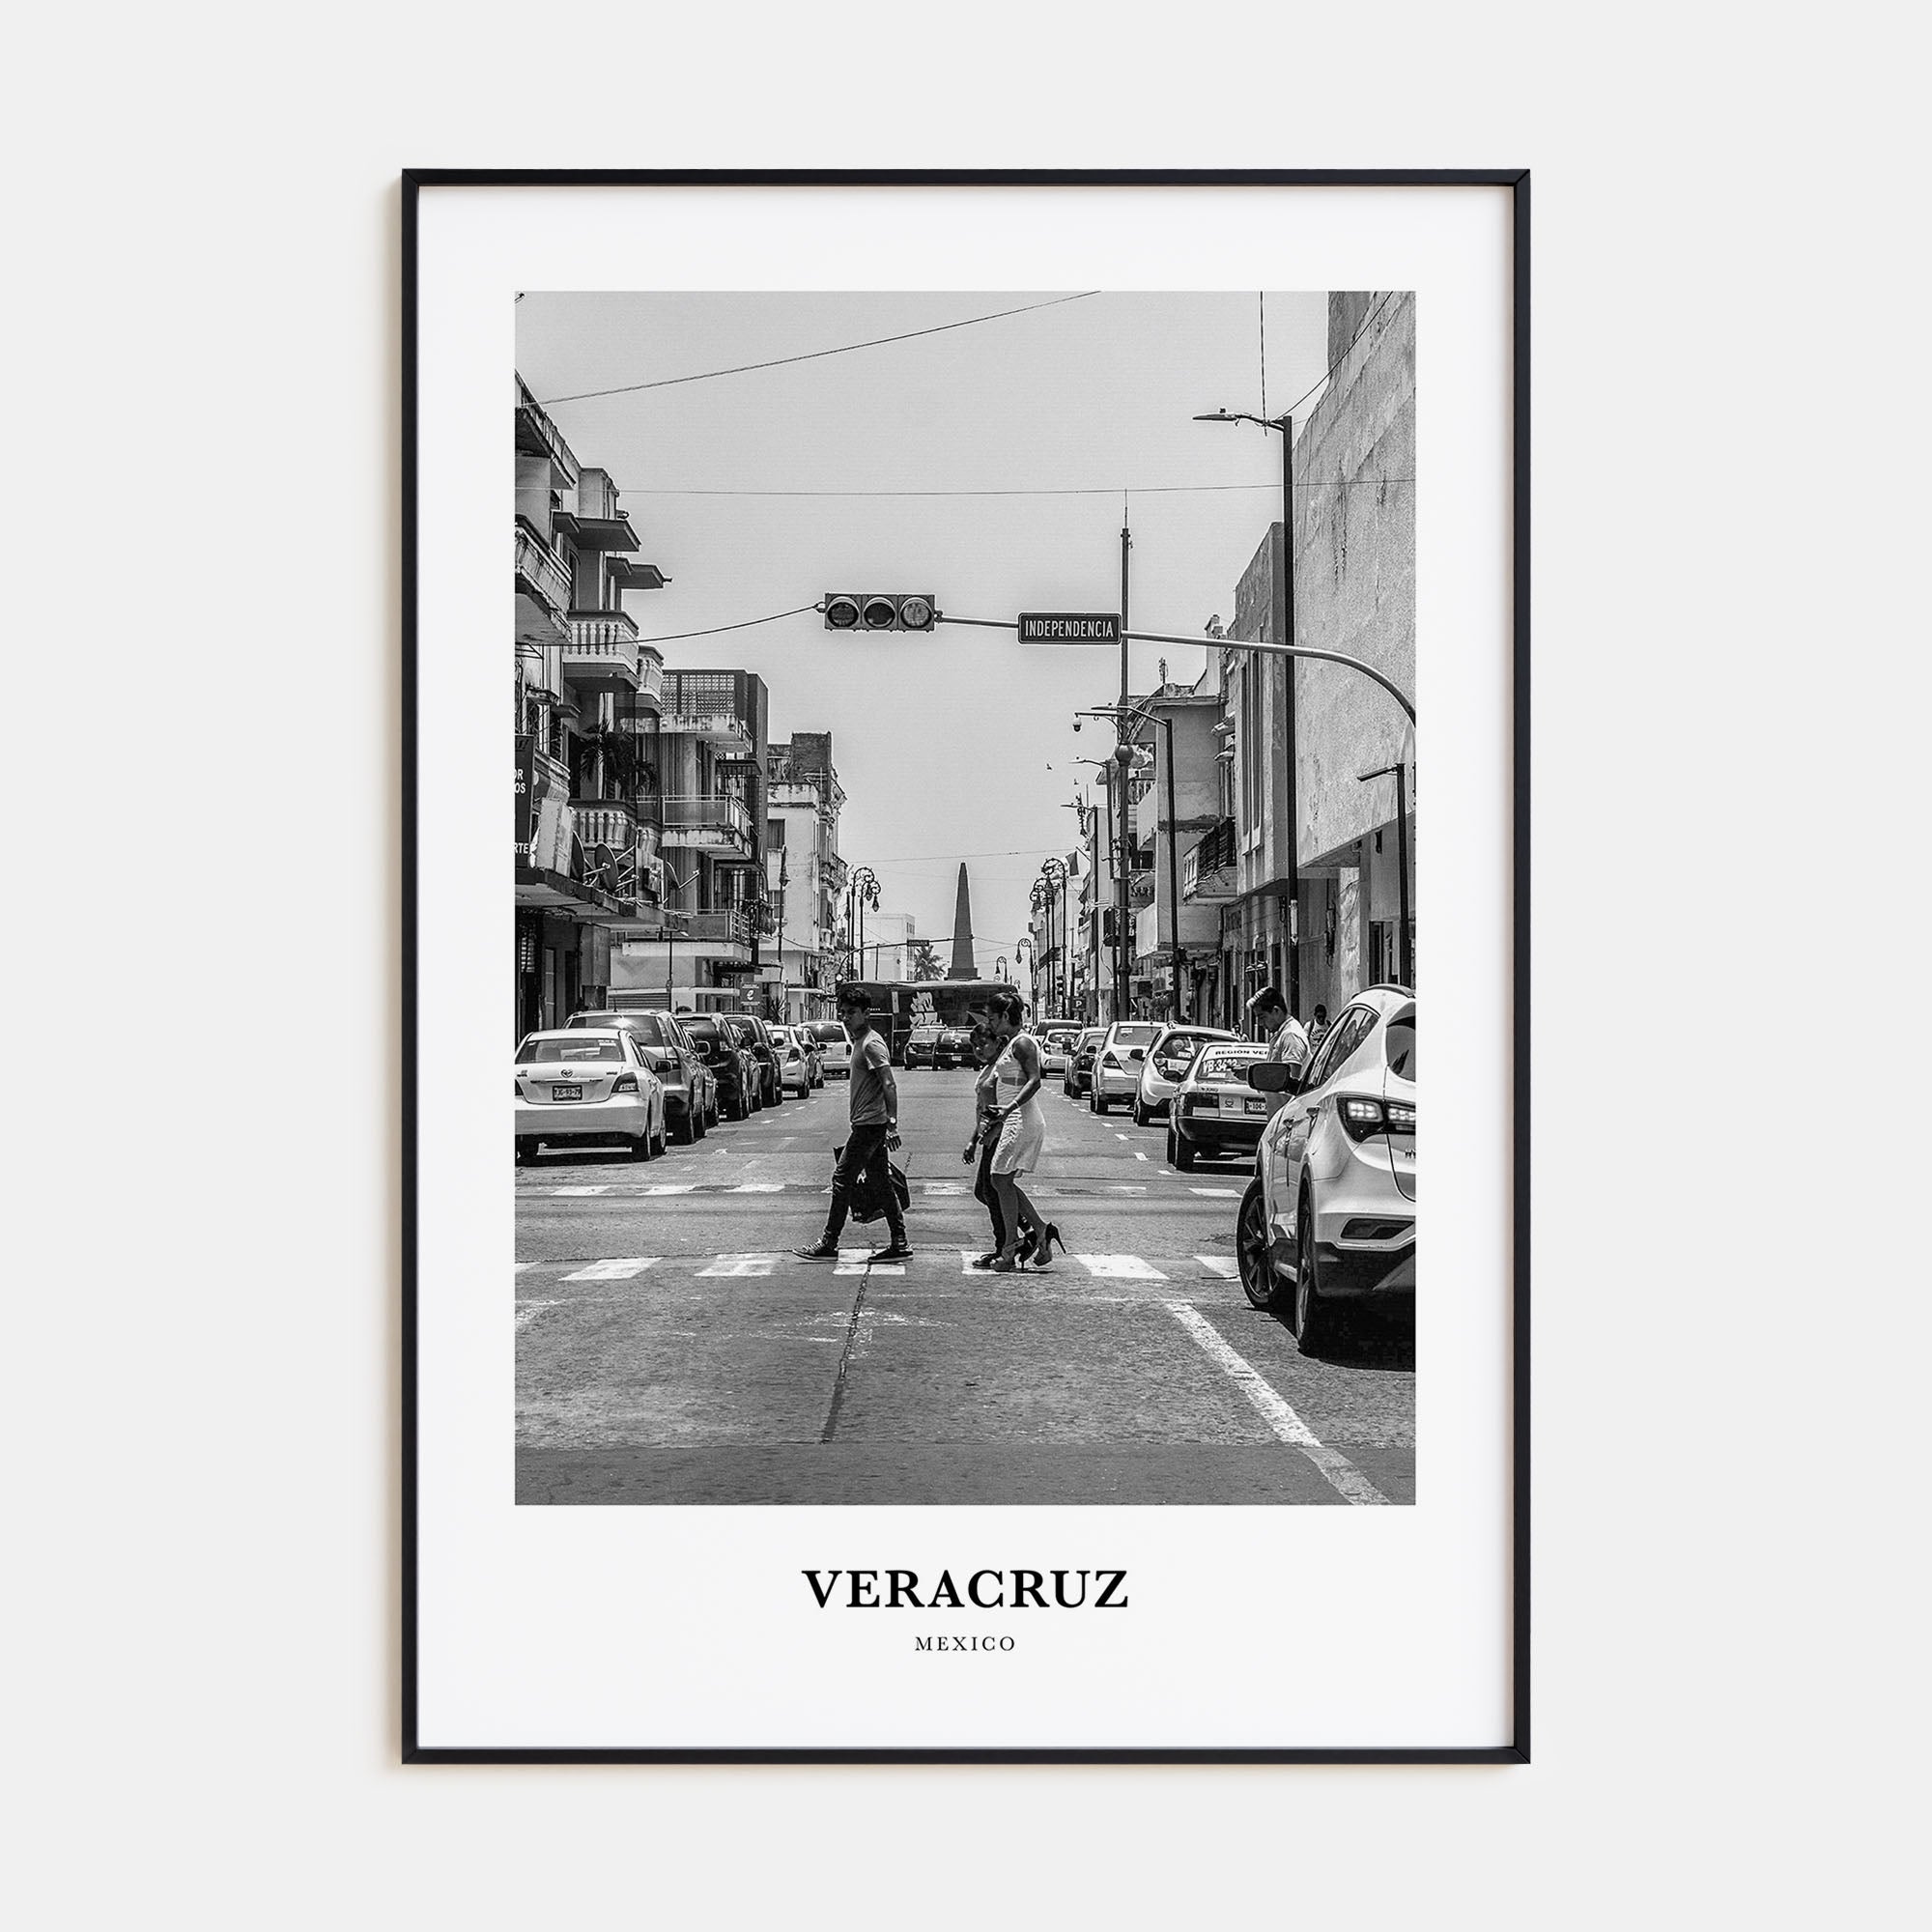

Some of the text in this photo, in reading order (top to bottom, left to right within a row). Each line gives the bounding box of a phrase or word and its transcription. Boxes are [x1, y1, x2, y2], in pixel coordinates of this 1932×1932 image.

[1025, 620, 1114, 638] INDEPENDENCIA
[801, 1569, 1129, 1608] VERACRUZ
[915, 1635, 1015, 1652] MEXICO
